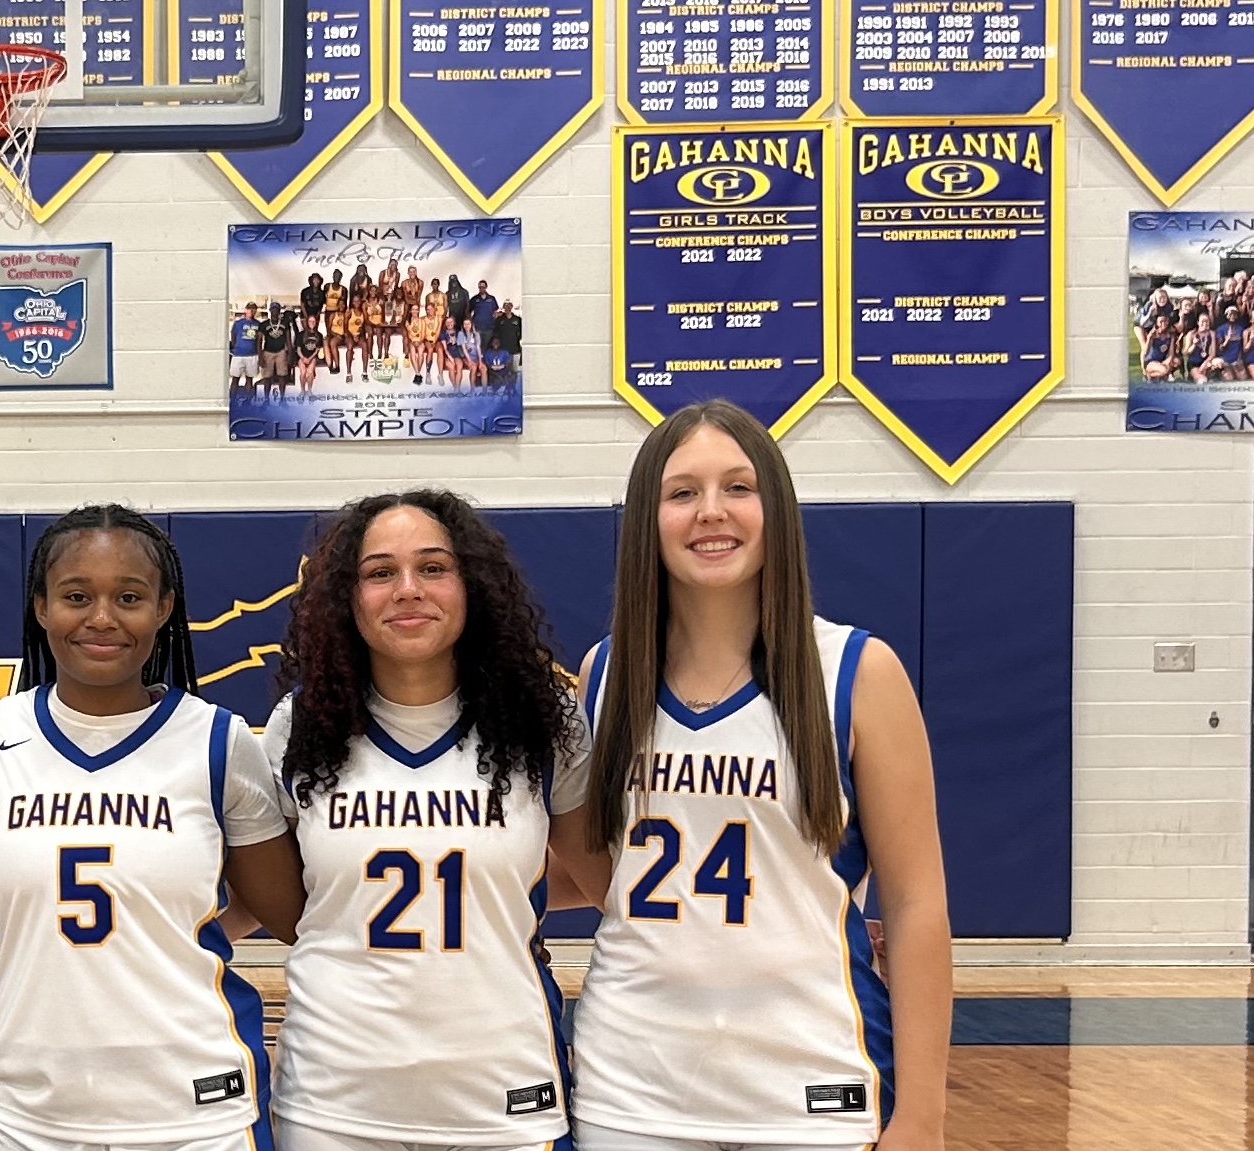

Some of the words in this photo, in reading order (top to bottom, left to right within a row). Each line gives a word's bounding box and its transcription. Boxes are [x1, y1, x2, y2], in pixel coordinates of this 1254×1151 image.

[669, 5, 724, 16] DISTRICT
[728, 4, 779, 15] CHAMPS
[893, 3, 949, 13] DISTRICT
[952, 2, 1003, 12] CHAMPS
[1120, 0, 1175, 9] DISTRICT
[1179, 0, 1231, 8] CHAMPS
[440, 9, 496, 19] DISTRICT
[499, 8, 550, 18] CHAMPS
[1228, 12, 1254, 26] 201
[775, 19, 811, 31] 2005
[938, 15, 973, 28] 1992
[458, 24, 495, 36] 2007
[9, 32, 42, 44] 1950
[97, 30, 130, 43] 1954
[856, 32, 892, 45] 2003
[897, 31, 932, 44] 2004
[938, 30, 974, 43] 2007
[1136, 31, 1168, 44] 2017
[413, 40, 446, 52] 2010
[458, 39, 491, 52] 2017
[505, 39, 540, 51] 2022
[552, 37, 589, 50] 2023
[640, 40, 676, 53] 2007
[684, 39, 717, 52] 2010
[730, 38, 763, 51] 2013
[776, 37, 809, 50] 2014
[897, 47, 930, 60] 2010
[938, 46, 969, 59] 2011
[984, 46, 1017, 59] 2012
[666, 63, 726, 75] REGIONAL
[729, 62, 781, 73] CHAMPS
[889, 62, 949, 72] REGIONAL
[953, 61, 1004, 71] CHAMPS
[1116, 57, 1176, 68] REGIONAL
[1180, 56, 1232, 66] CHAMPS
[437, 70, 497, 81] REGIONAL
[500, 69, 551, 79] CHAMPS
[640, 81, 676, 94] 2007
[685, 81, 719, 94] 2013
[731, 80, 766, 93] 2015
[863, 78, 894, 91] 1991
[899, 78, 934, 91] 2013
[324, 87, 360, 101] 2007
[641, 99, 674, 111] 2017
[776, 95, 809, 108] 2021
[859, 132, 1044, 175] GAHANNA
[631, 138, 815, 183] GAHANNA
[660, 215, 718, 226] GIRLS
[725, 213, 788, 224] TRACK
[860, 209, 912, 220] BOYS
[920, 207, 1044, 219] VOLLEYBALL
[1132, 214, 1254, 232] GAHAN
[233, 227, 402, 243] GAHANNA
[414, 223, 519, 240] LIONS
[883, 230, 963, 241] CONFERENCE
[965, 229, 1017, 240] CHAMPS
[656, 236, 734, 248] CONFERENCE
[737, 235, 789, 245] CHAMPS
[681, 250, 714, 263] 2021
[727, 248, 762, 261] 2022
[25, 298, 56, 309] OHIO
[668, 302, 724, 314] DISTRICT
[726, 301, 779, 313] CHAMPS
[895, 296, 951, 307] DISTRICT
[953, 295, 1006, 307] CHAMPS
[14, 306, 67, 322] CAPITAL
[862, 309, 894, 322] 2021
[907, 309, 943, 321] 2022
[955, 308, 991, 321] 2023
[681, 316, 713, 329] 2021
[726, 315, 761, 328] 2022
[22, 340, 53, 364] 50
[666, 360, 726, 371] REGIONAL
[729, 359, 782, 370] CHAMPS
[892, 354, 953, 365] REGIONAL
[956, 353, 1008, 364] CHAMPS
[637, 373, 672, 386] 2022
[319, 408, 434, 418] STATE
[231, 416, 520, 439] CHAMPIONS
[626, 752, 779, 802] AHANNA
[7, 792, 175, 834] GAHANNA
[328, 789, 507, 830] GAHANNA
[626, 814, 755, 928] 24
[56, 843, 117, 948] 5
[362, 847, 467, 952] 21
[229, 1078, 240, 1091] M
[541, 1090, 551, 1102] M
[849, 1092, 859, 1104] L
